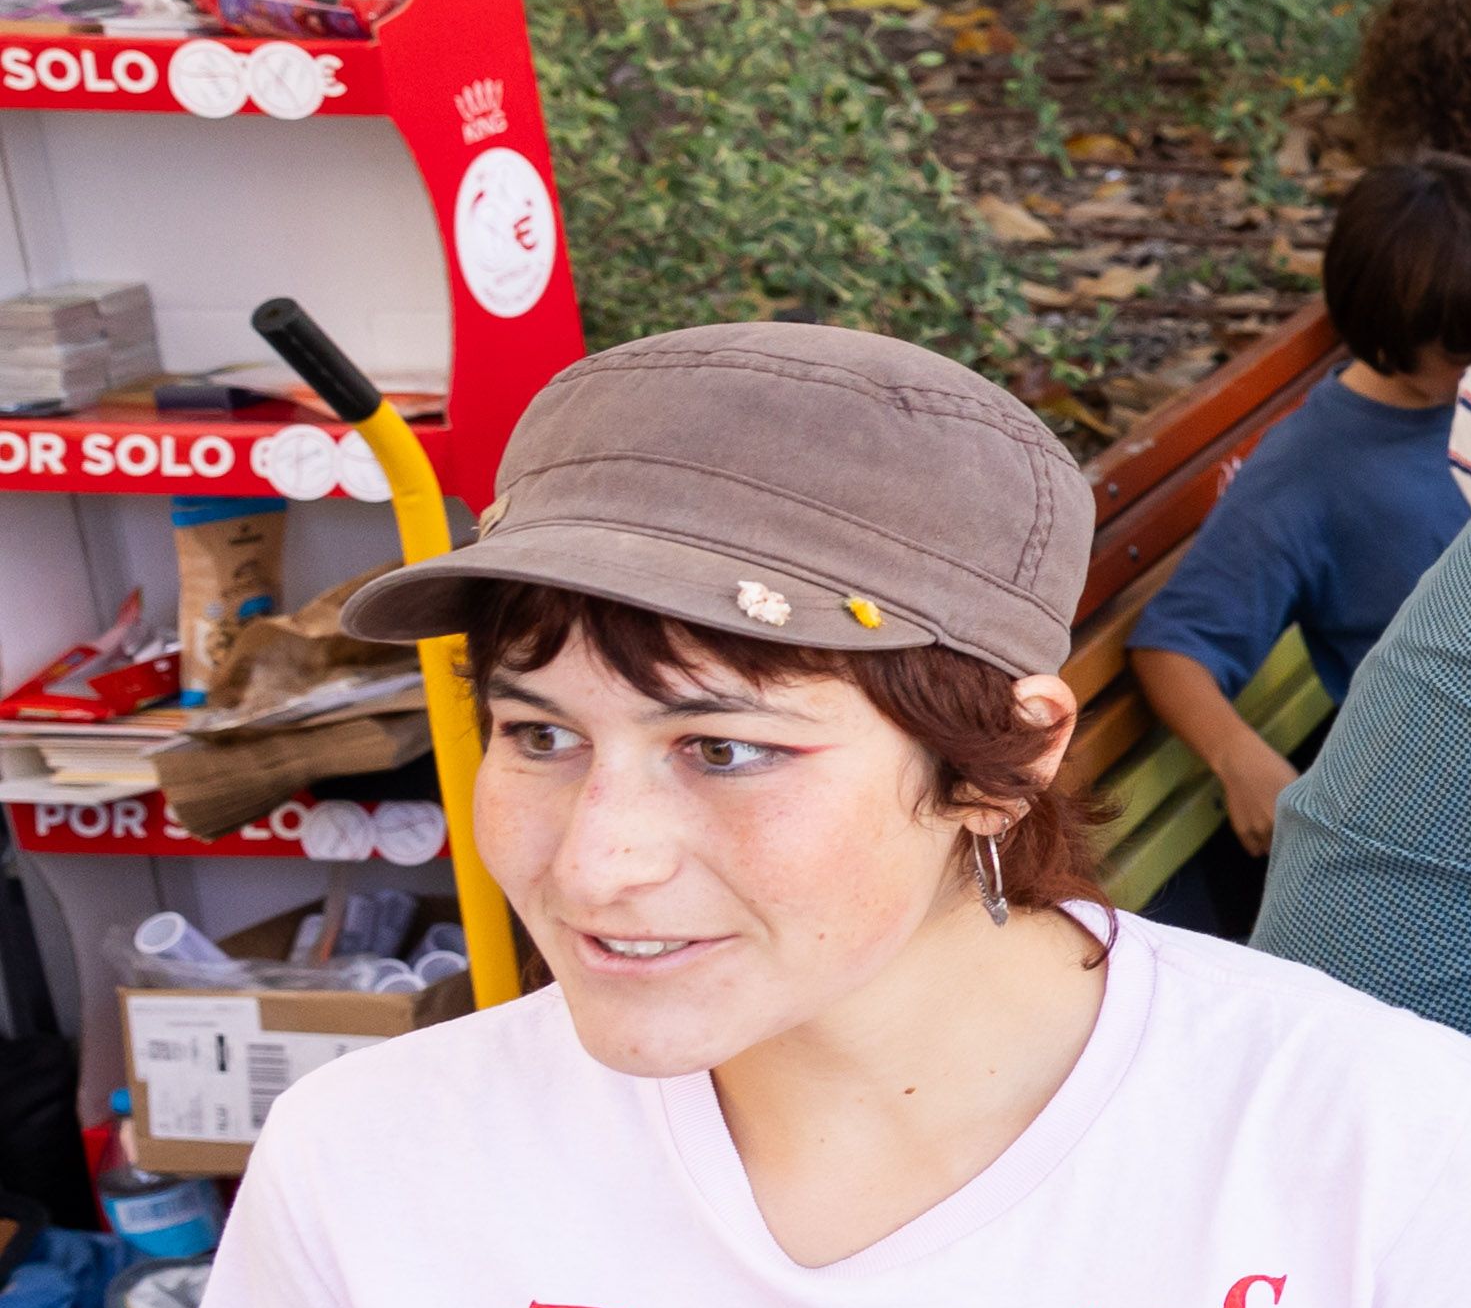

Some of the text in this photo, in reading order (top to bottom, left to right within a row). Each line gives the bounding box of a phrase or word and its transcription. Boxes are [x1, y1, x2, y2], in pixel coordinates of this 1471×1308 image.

[3, 48, 158, 93] SOLO
[82, 434, 235, 478] SOLO
[34, 802, 304, 842] POR SLO
